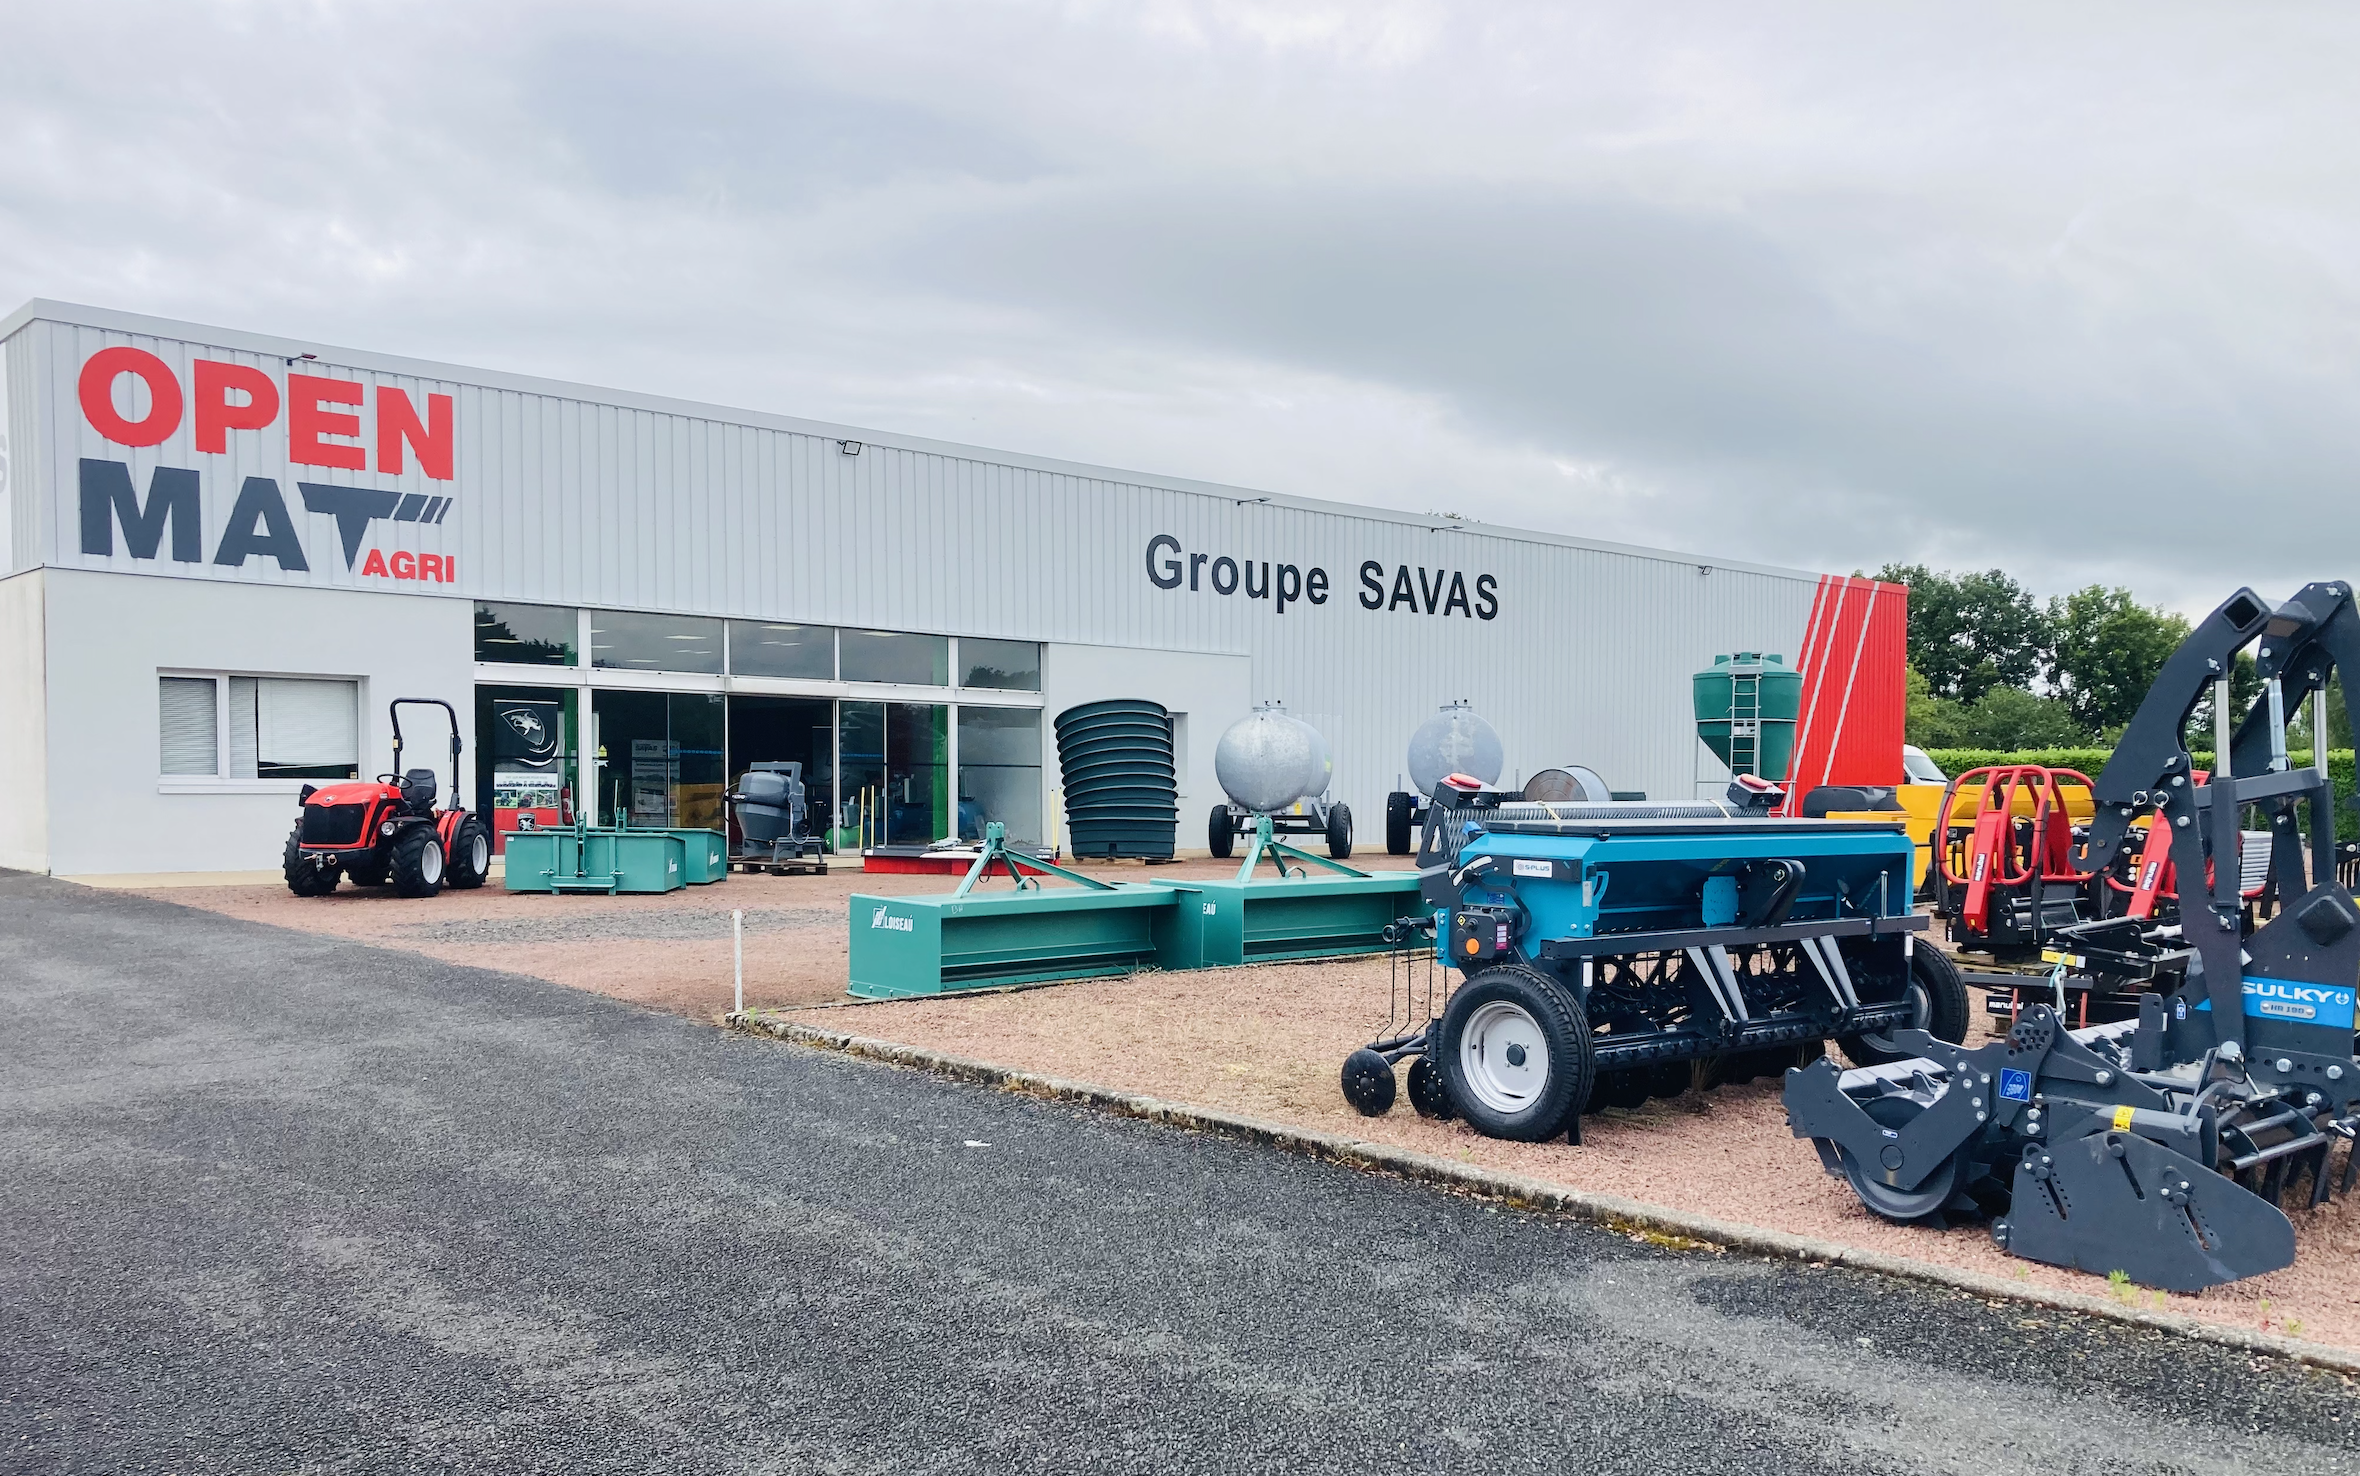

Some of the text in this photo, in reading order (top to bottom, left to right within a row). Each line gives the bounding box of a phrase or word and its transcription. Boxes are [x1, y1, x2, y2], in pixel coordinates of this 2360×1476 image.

[79, 346, 454, 480] OPEN
[79, 458, 403, 572] MAT
[361, 549, 455, 583] AGRI
[1146, 534, 1499, 621] Groupe SAVAS
[2241, 982, 2335, 1003] SULKY
